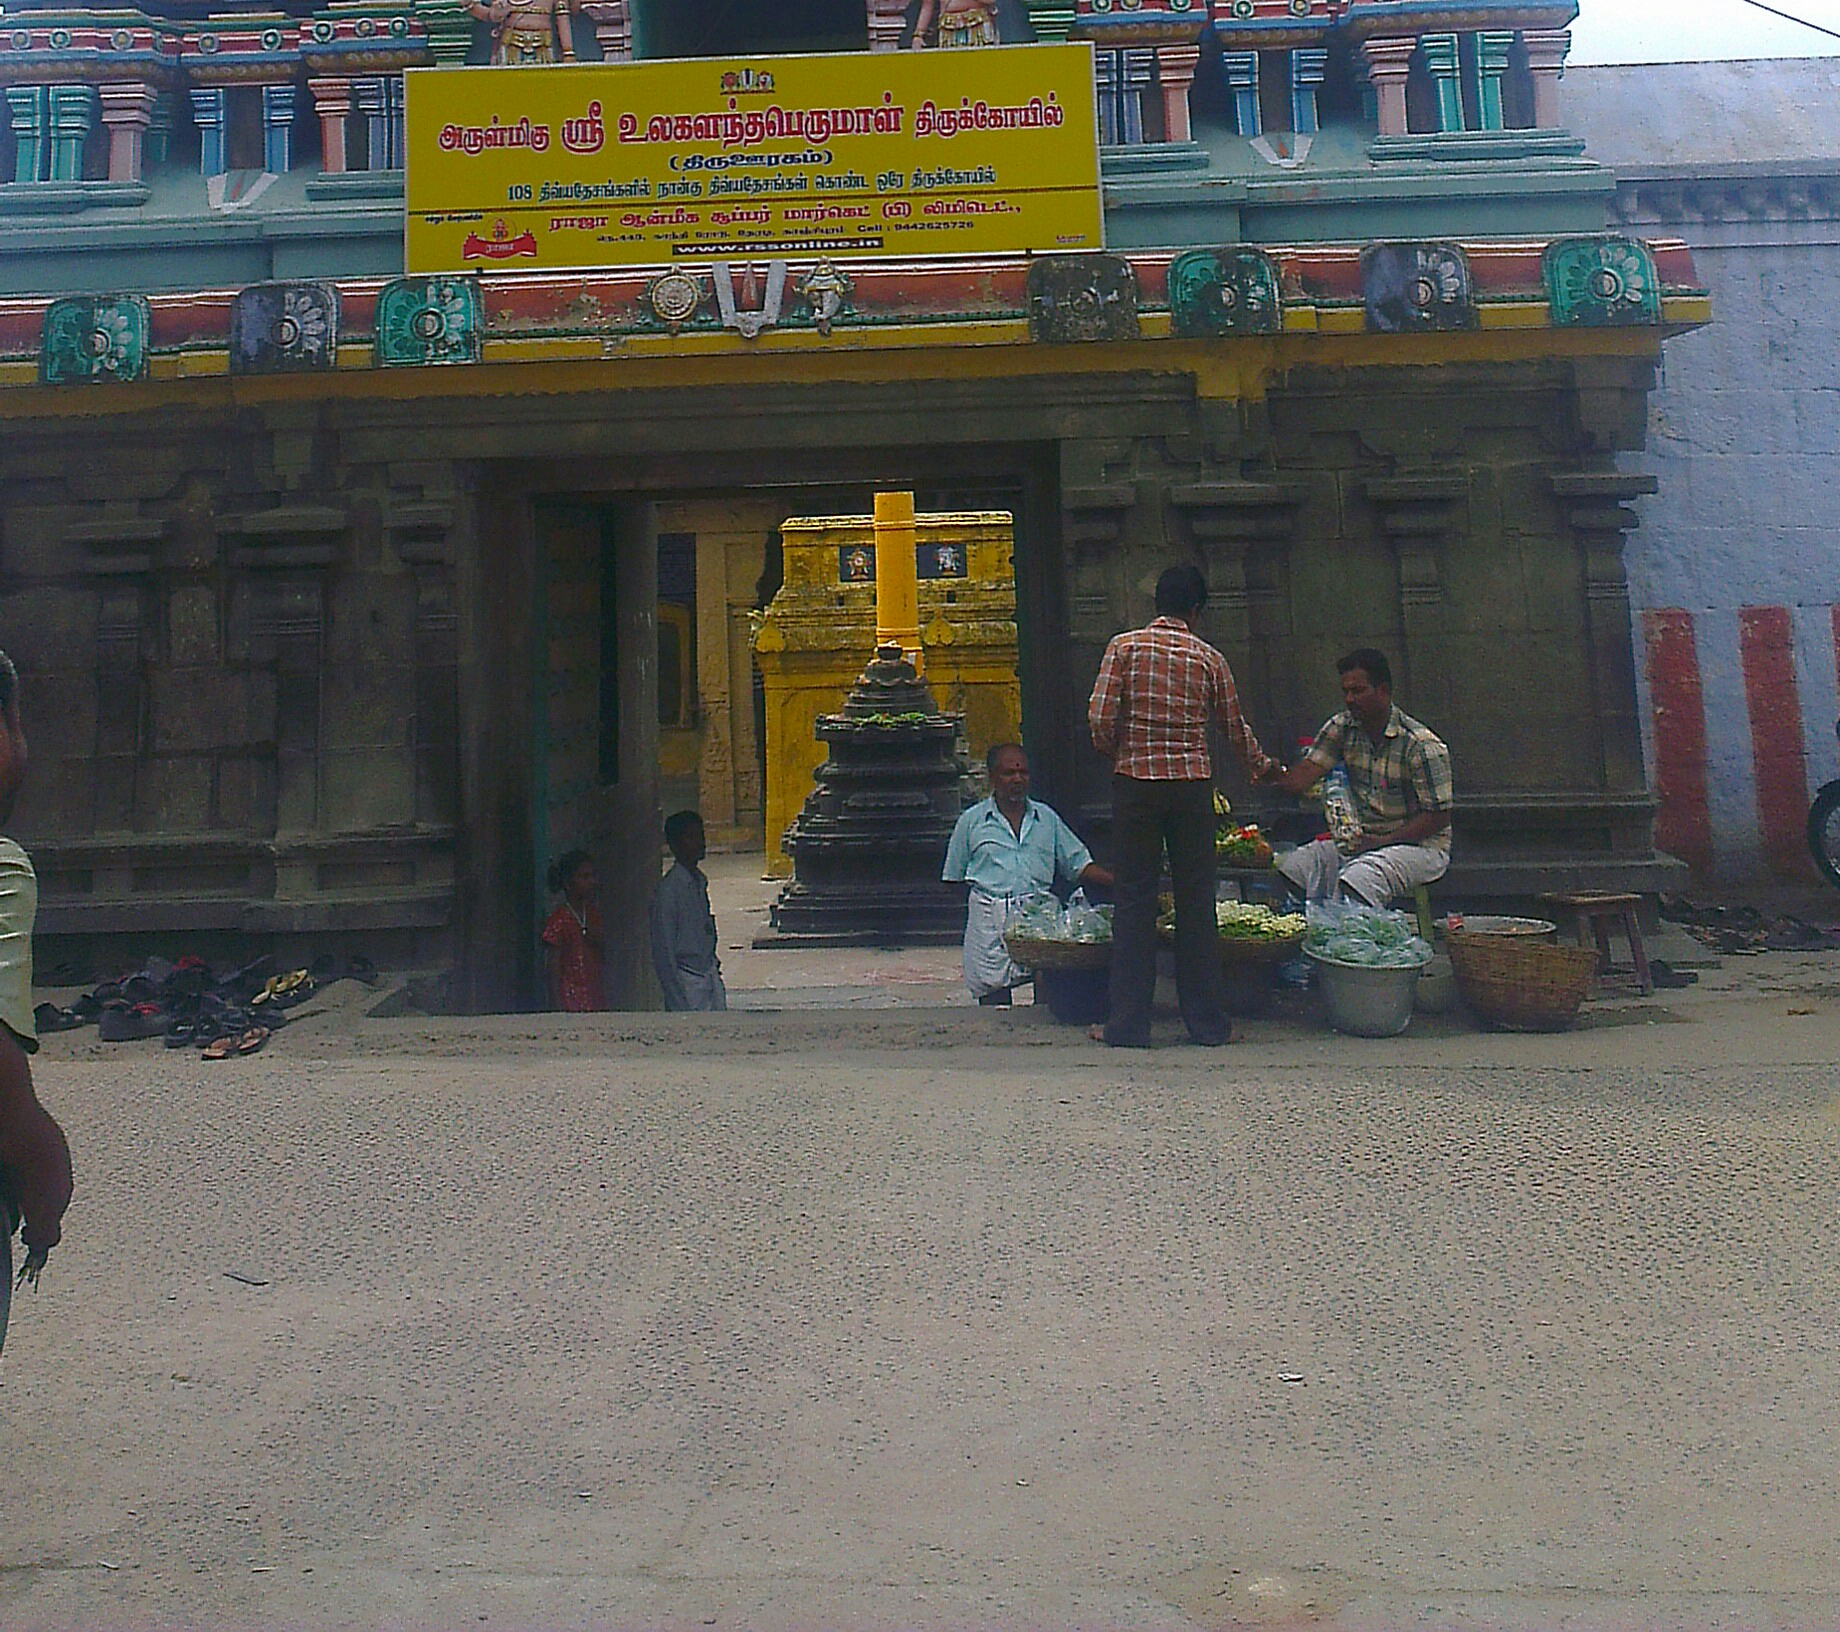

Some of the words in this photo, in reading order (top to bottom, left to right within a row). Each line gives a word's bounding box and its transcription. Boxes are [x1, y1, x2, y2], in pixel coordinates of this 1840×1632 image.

[439, 115, 550, 155] அருள்மிகு
[618, 92, 904, 146] உலகளந்தபெருமாள்
[915, 92, 1064, 138] திருக்கோயில்
[508, 184, 533, 201] 108
[657, 175, 703, 199] நான்கு
[815, 169, 870, 189] கொண்ட
[548, 216, 609, 232] ராஜா
[881, 201, 912, 219] (பி)
[856, 224, 883, 233] Cell
[677, 238, 879, 253] www.rssonline.in
